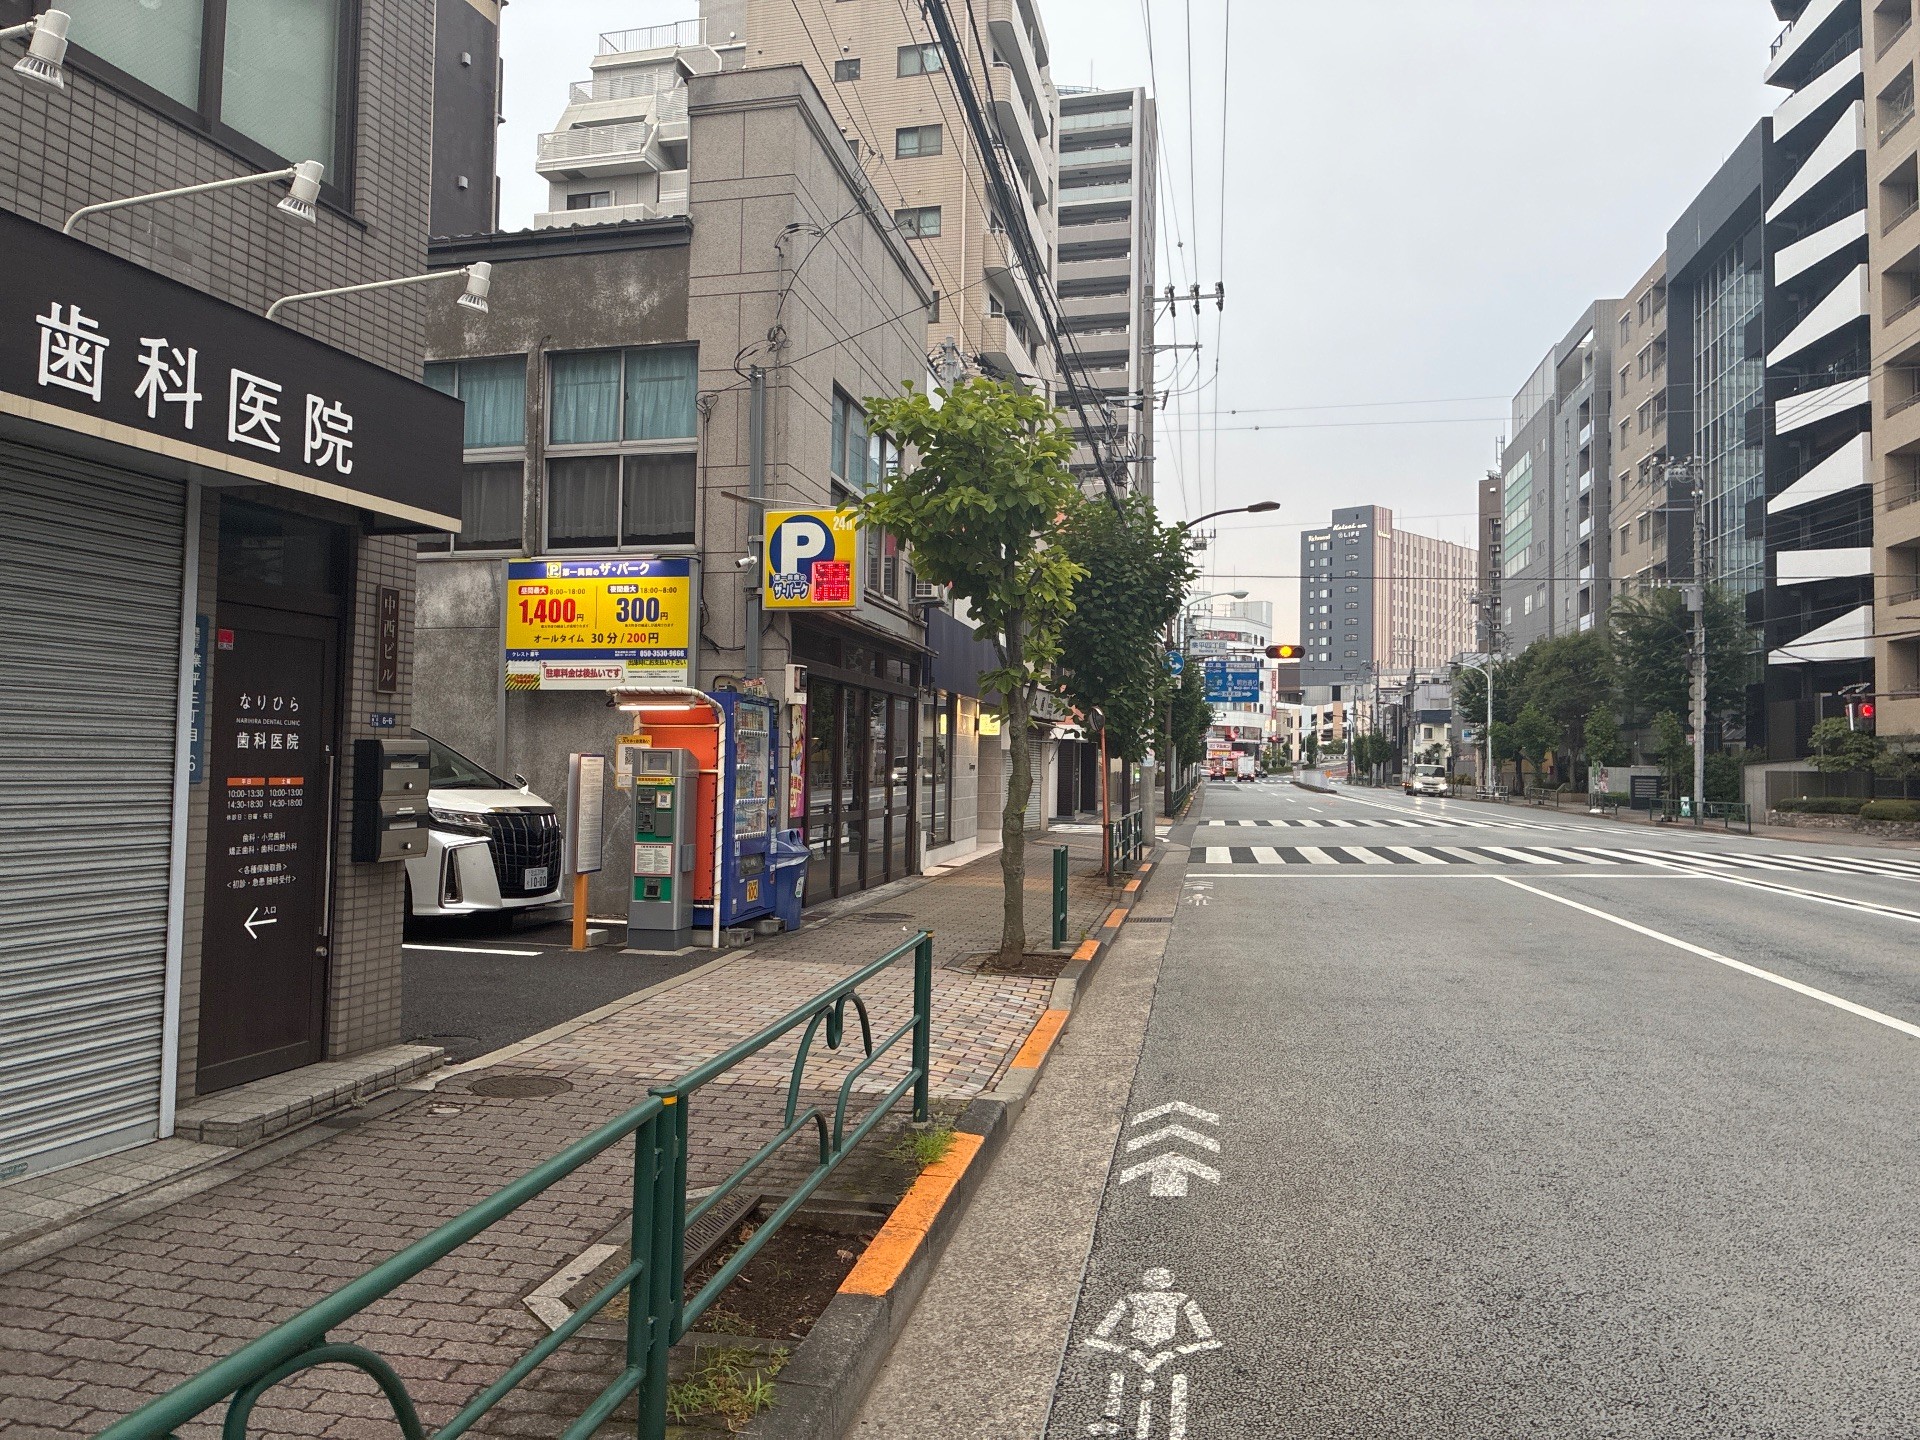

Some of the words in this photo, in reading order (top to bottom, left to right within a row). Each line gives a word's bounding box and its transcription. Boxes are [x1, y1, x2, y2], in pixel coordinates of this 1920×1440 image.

[36, 301, 354, 475] 歯科医院
[780, 522, 826, 576] P
[775, 583, 809, 600] ザ・パーク
[381, 595, 396, 682] 中西ビル
[533, 633, 585, 644] オールタイム
[545, 668, 622, 679] 駐車料金は後払いです
[240, 692, 299, 712] なりひら
[237, 731, 299, 750] 歯科医院
[228, 789, 264, 798] 10:00-13:30
[269, 788, 304, 797] 10:00-13:00
[227, 800, 264, 809] 14:30-18:30
[268, 798, 303, 807] 14:30-18:00
[263, 905, 277, 915] 入口
